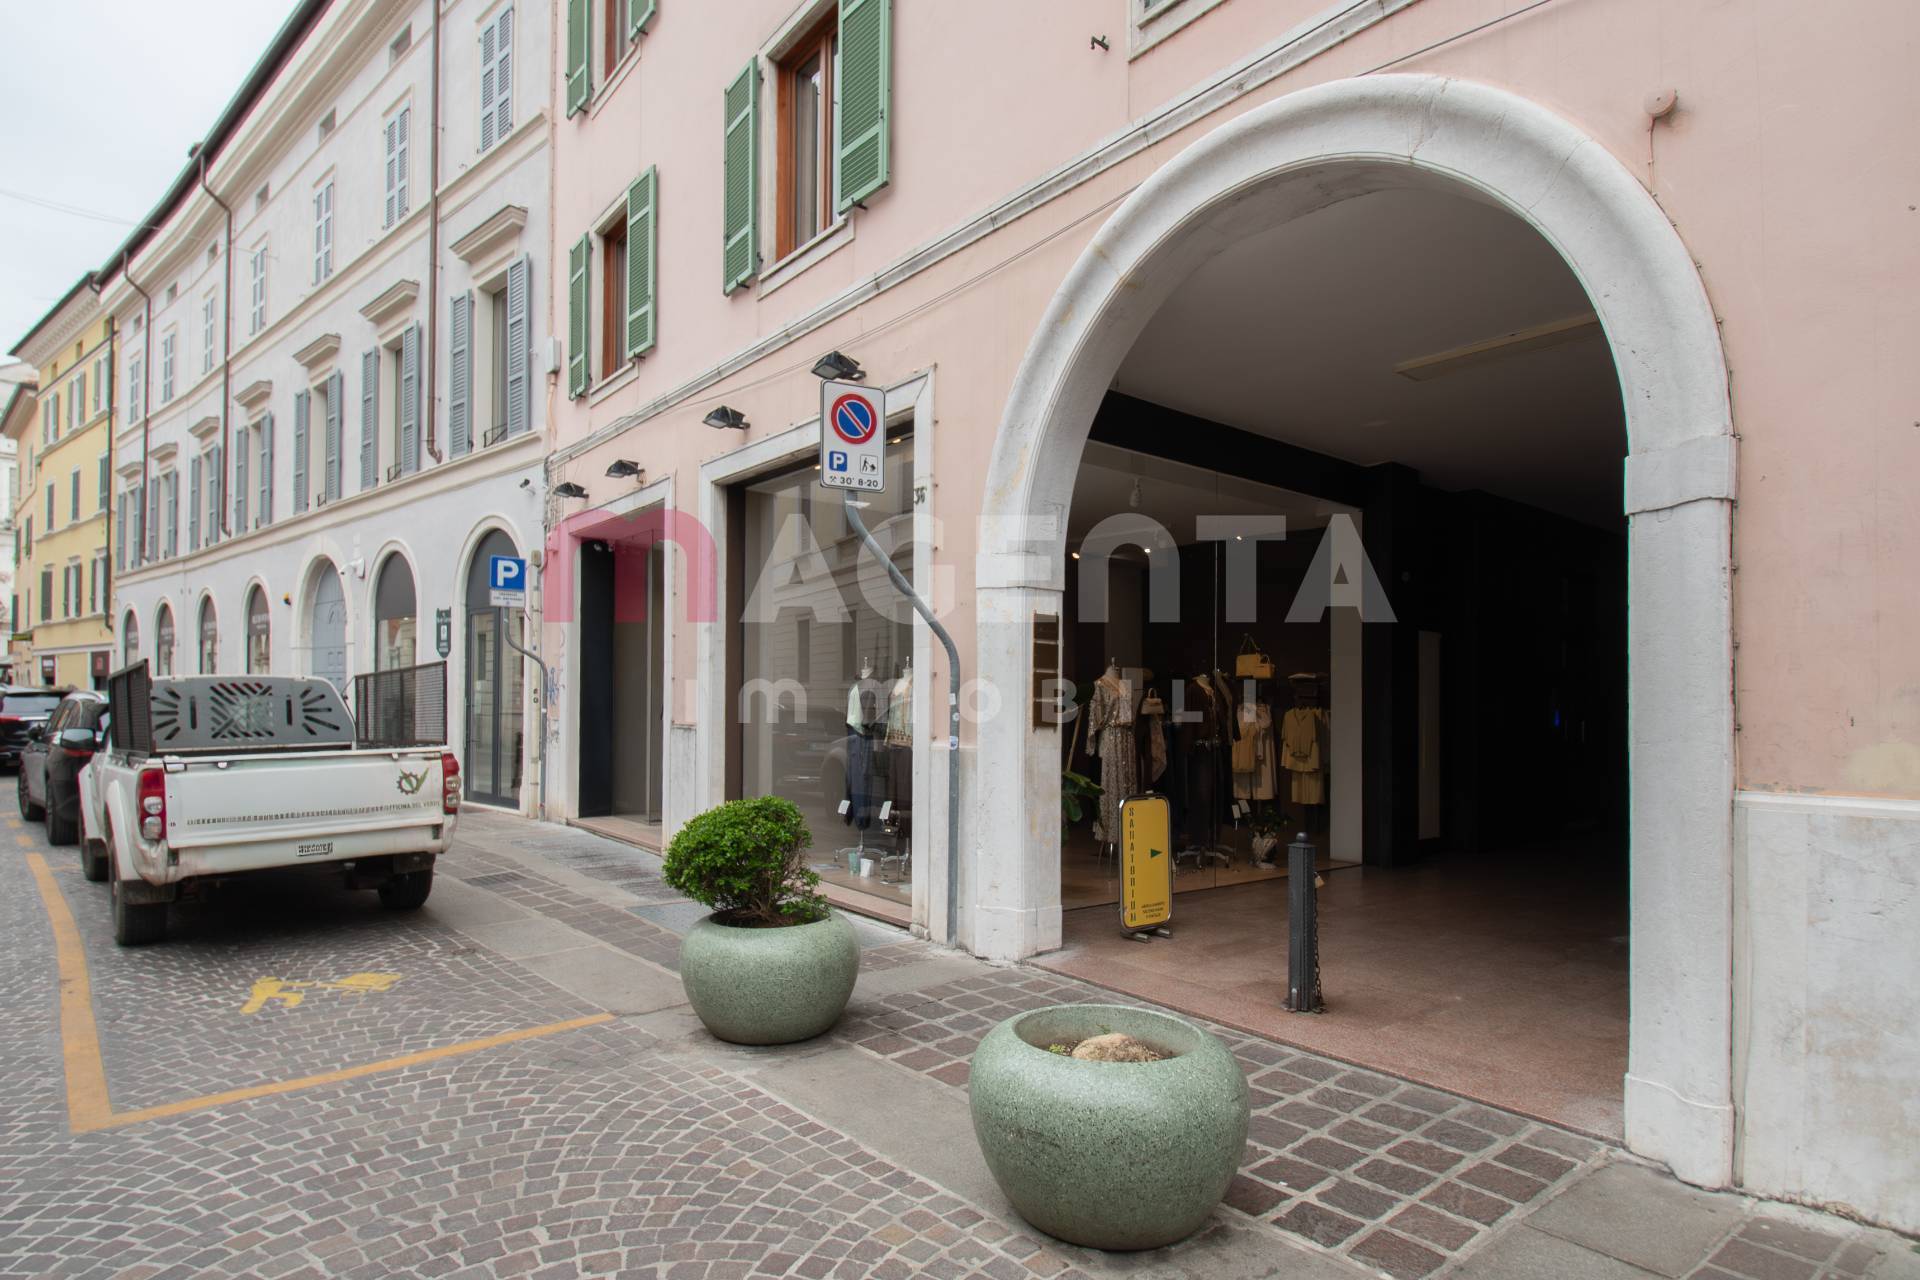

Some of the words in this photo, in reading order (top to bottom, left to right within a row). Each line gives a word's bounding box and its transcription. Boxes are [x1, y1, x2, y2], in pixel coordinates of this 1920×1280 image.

[833, 454, 845, 470] P
[858, 478, 879, 488] 8-20
[497, 559, 519, 587] P
